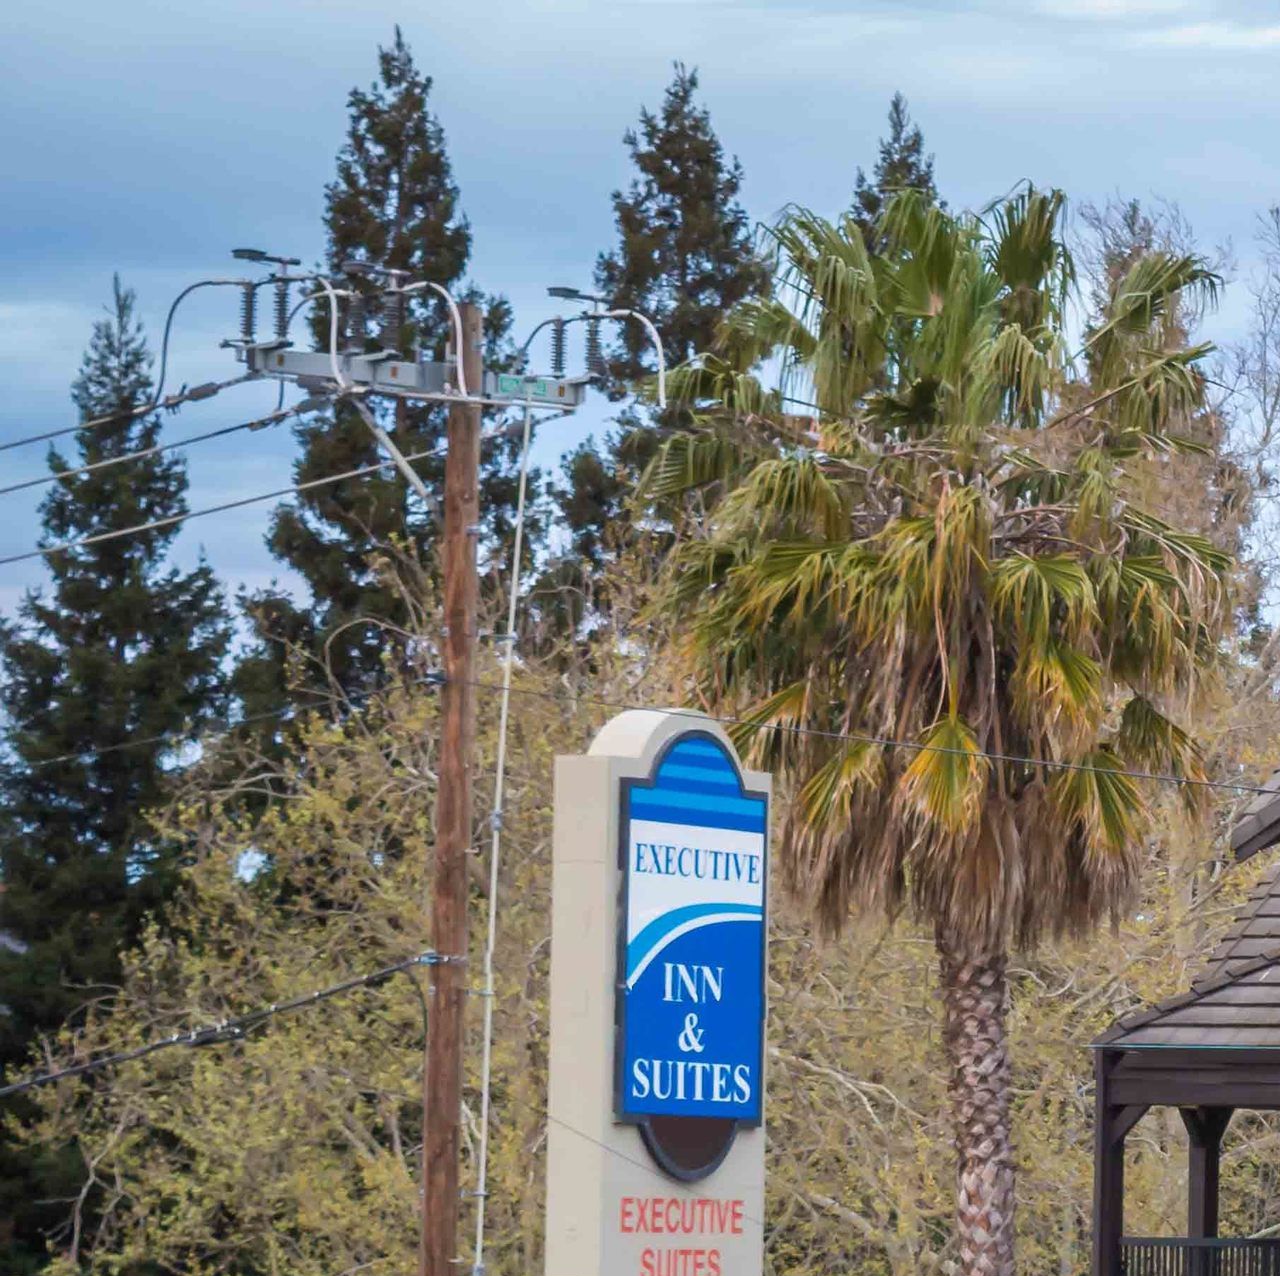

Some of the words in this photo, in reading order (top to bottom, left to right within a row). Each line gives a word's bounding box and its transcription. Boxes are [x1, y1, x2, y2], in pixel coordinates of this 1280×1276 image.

[634, 842, 760, 885] EXECUTIVE
[663, 962, 723, 1004] INN
[677, 1011, 705, 1053] &
[632, 1058, 751, 1104] SUITES
[620, 1197, 744, 1235] EXECUTIVE
